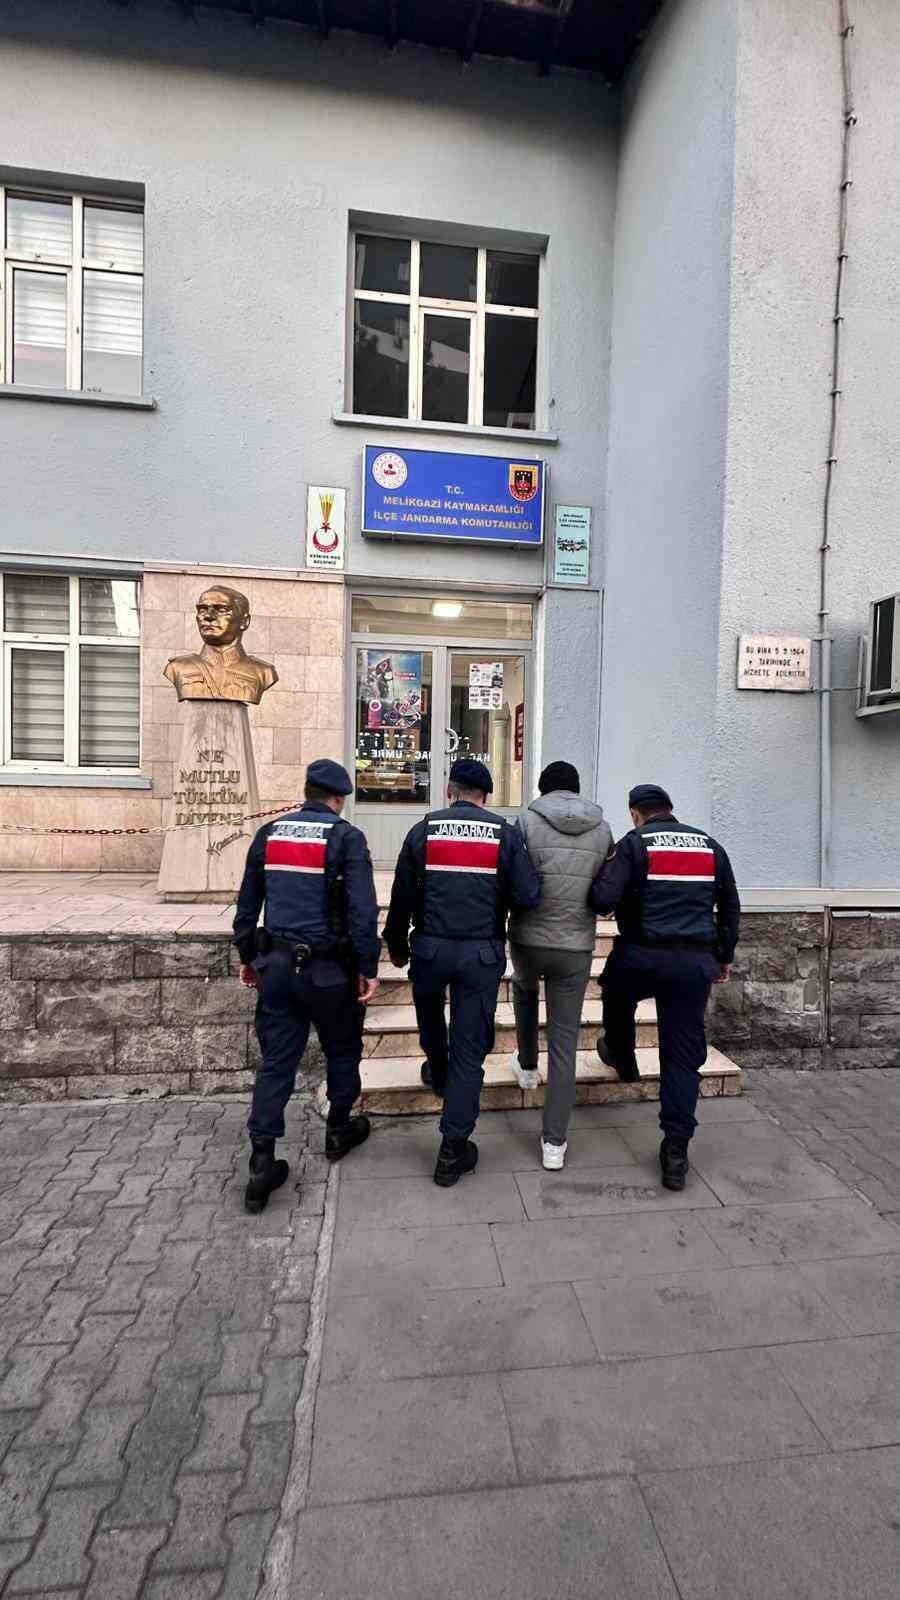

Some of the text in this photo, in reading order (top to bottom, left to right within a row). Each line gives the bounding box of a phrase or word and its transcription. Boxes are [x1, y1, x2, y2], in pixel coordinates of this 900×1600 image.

[445, 484, 464, 495] T.C.
[383, 495, 524, 515] MELİKGAZİ KAYMAKAMLIĞI
[373, 510, 533, 531] İLÇE JANDARMA KOMUTANLIĞI
[196, 750, 224, 763] NE
[179, 769, 240, 784] MUTLU
[173, 786, 248, 805] TÜRKÜM
[434, 823, 495, 839] JANDARMA
[653, 834, 708, 849] JANDARMA
